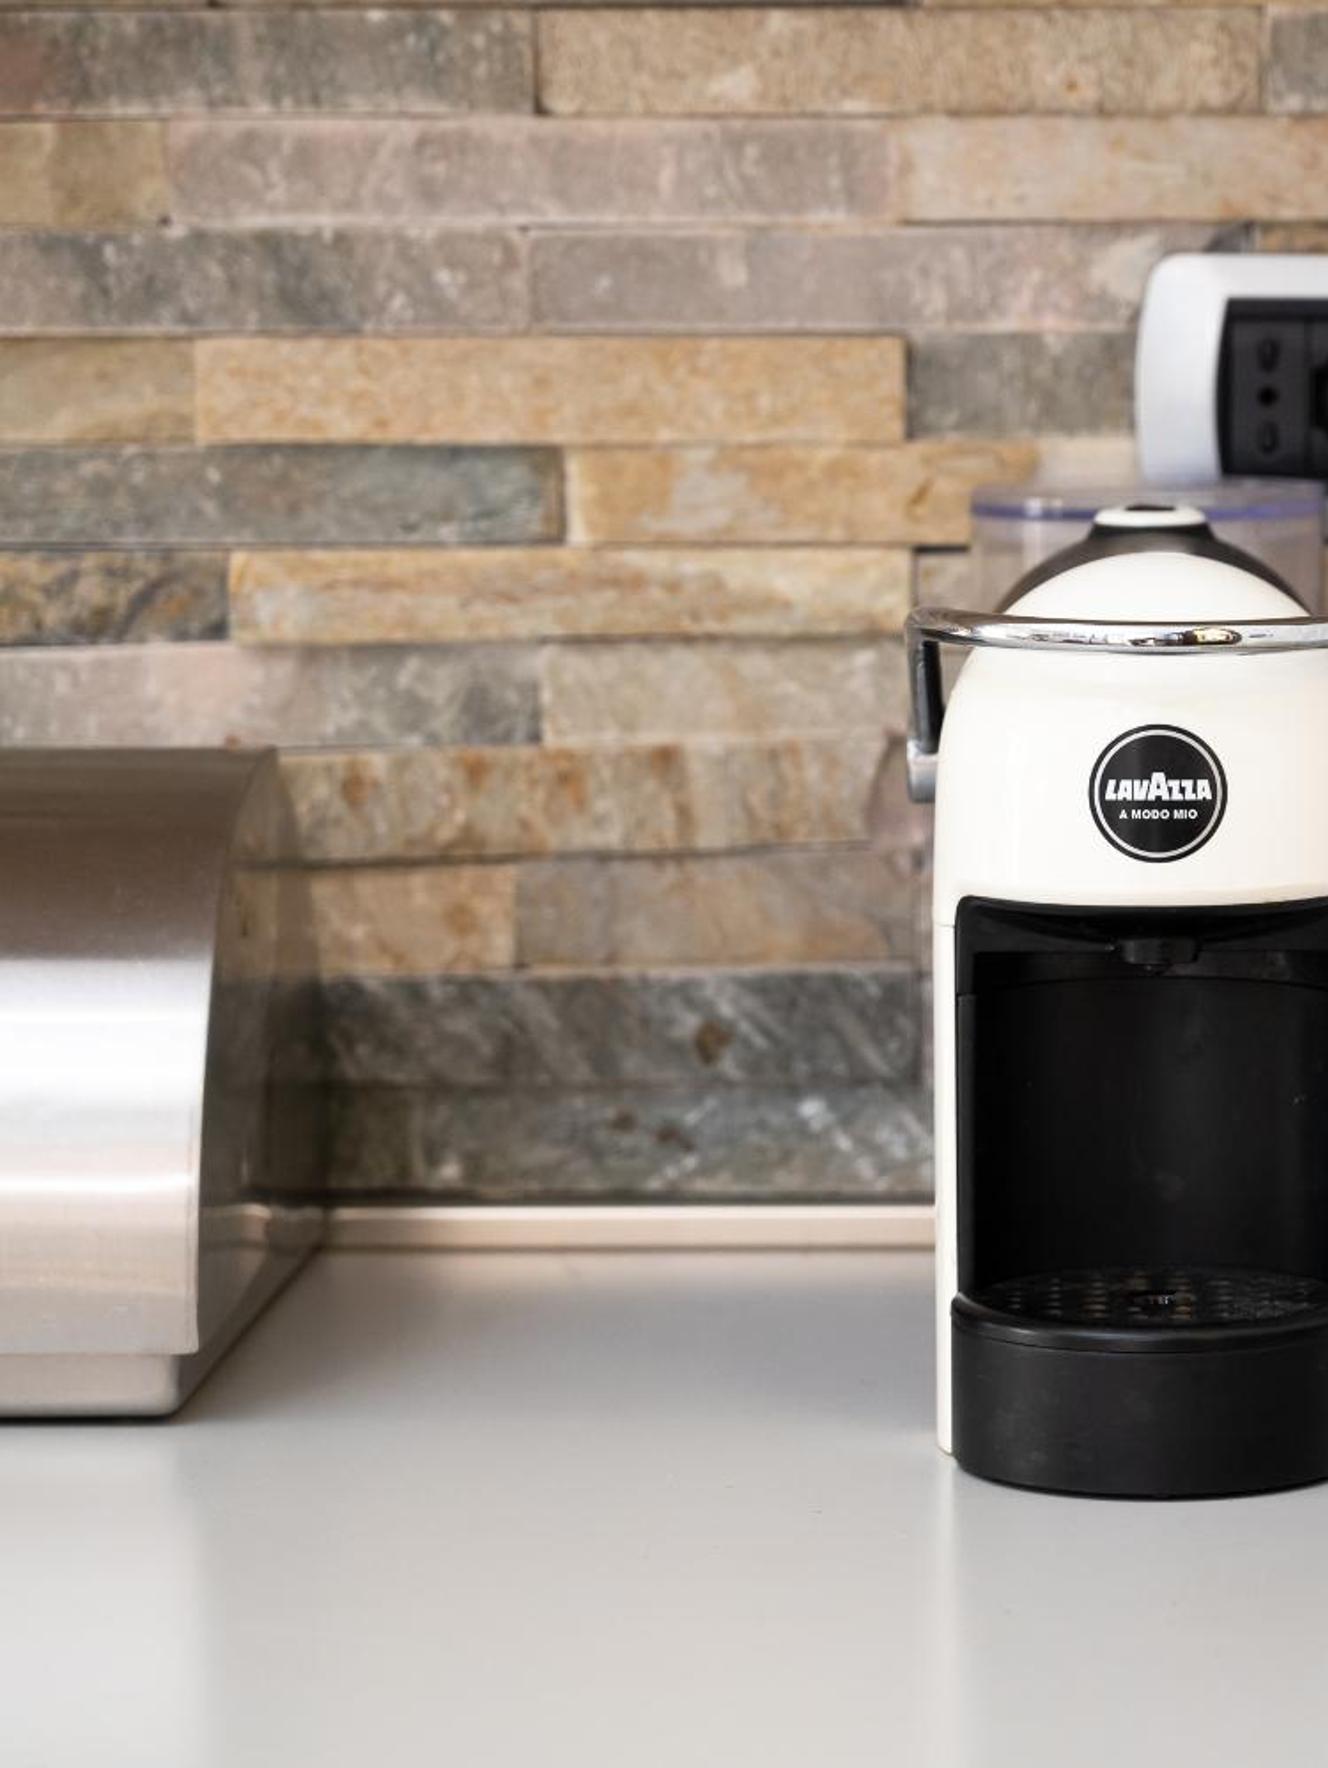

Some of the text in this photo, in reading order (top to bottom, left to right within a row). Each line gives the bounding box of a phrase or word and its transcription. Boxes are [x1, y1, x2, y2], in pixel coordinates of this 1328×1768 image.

[1105, 771, 1213, 801] LAVAZZA
[1119, 808, 1198, 819] A MODO MIO
